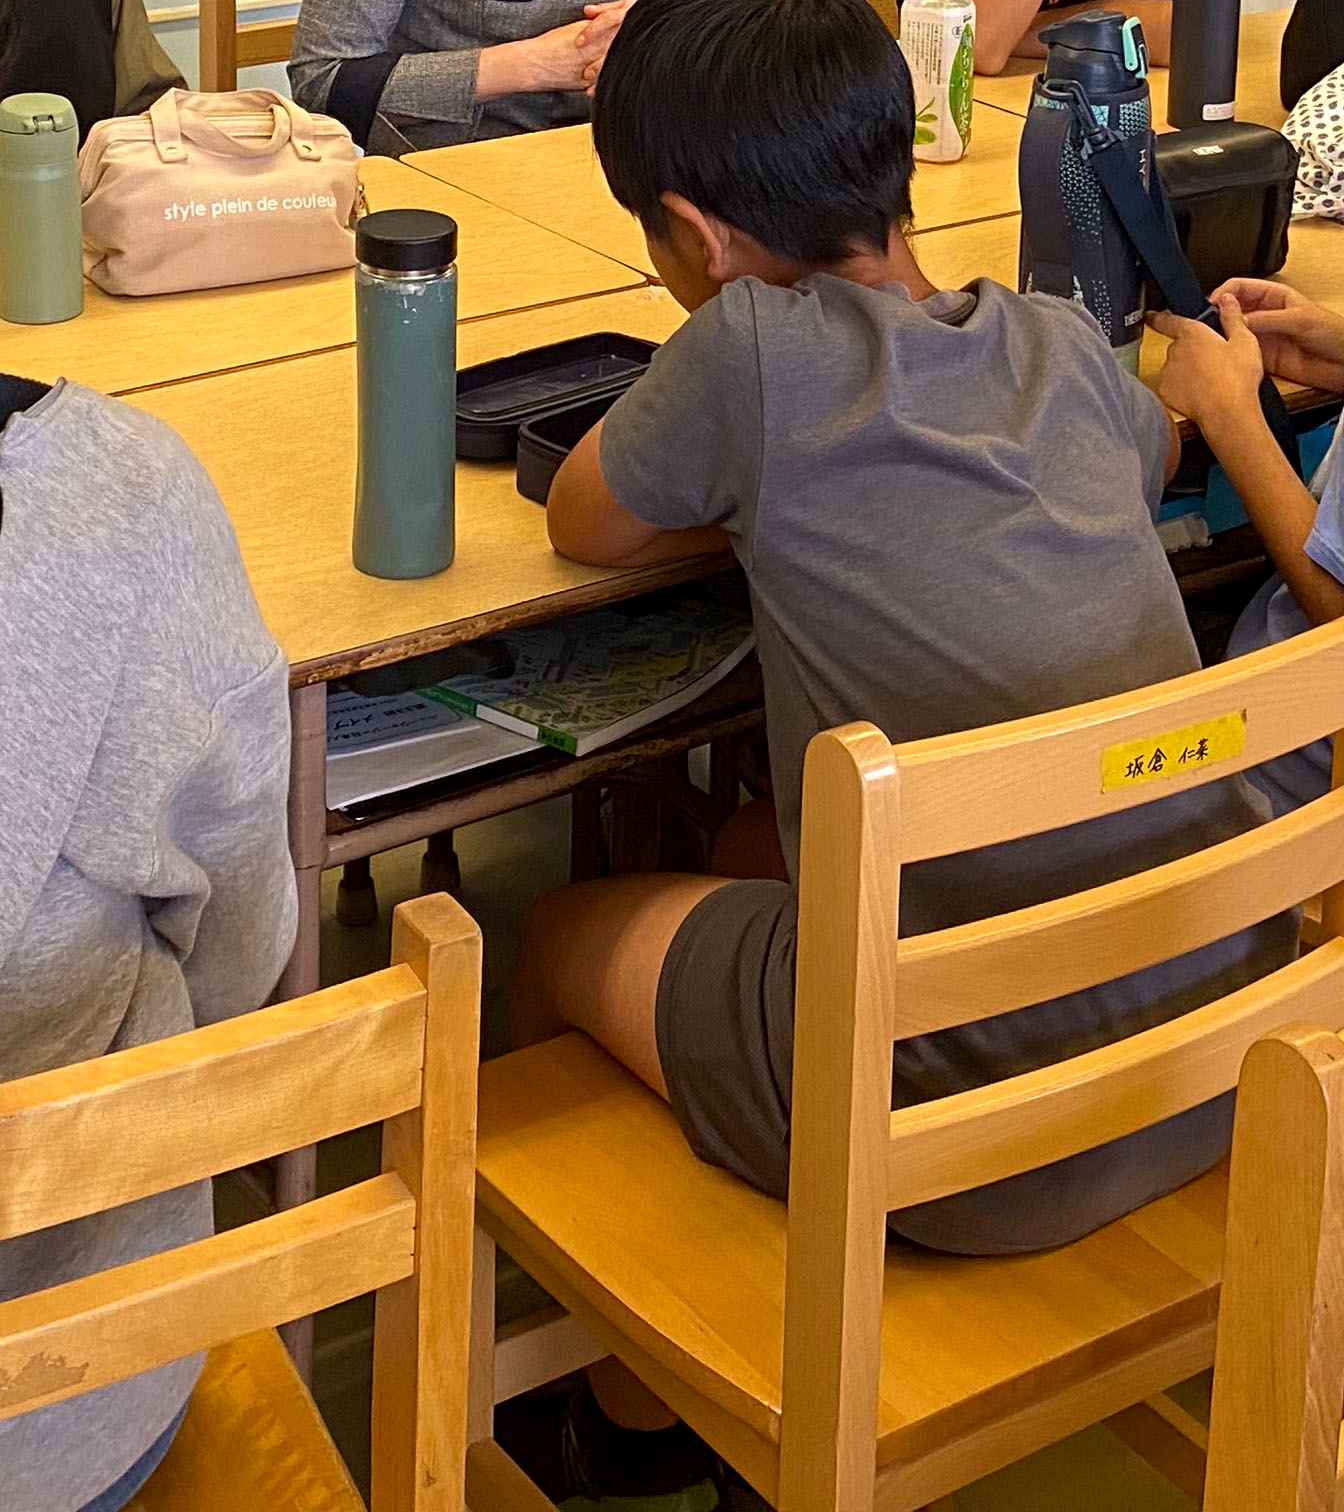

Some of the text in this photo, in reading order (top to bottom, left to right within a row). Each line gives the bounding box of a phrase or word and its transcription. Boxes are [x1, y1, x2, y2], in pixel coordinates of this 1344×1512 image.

[163, 192, 337, 222] style plein de couleu
